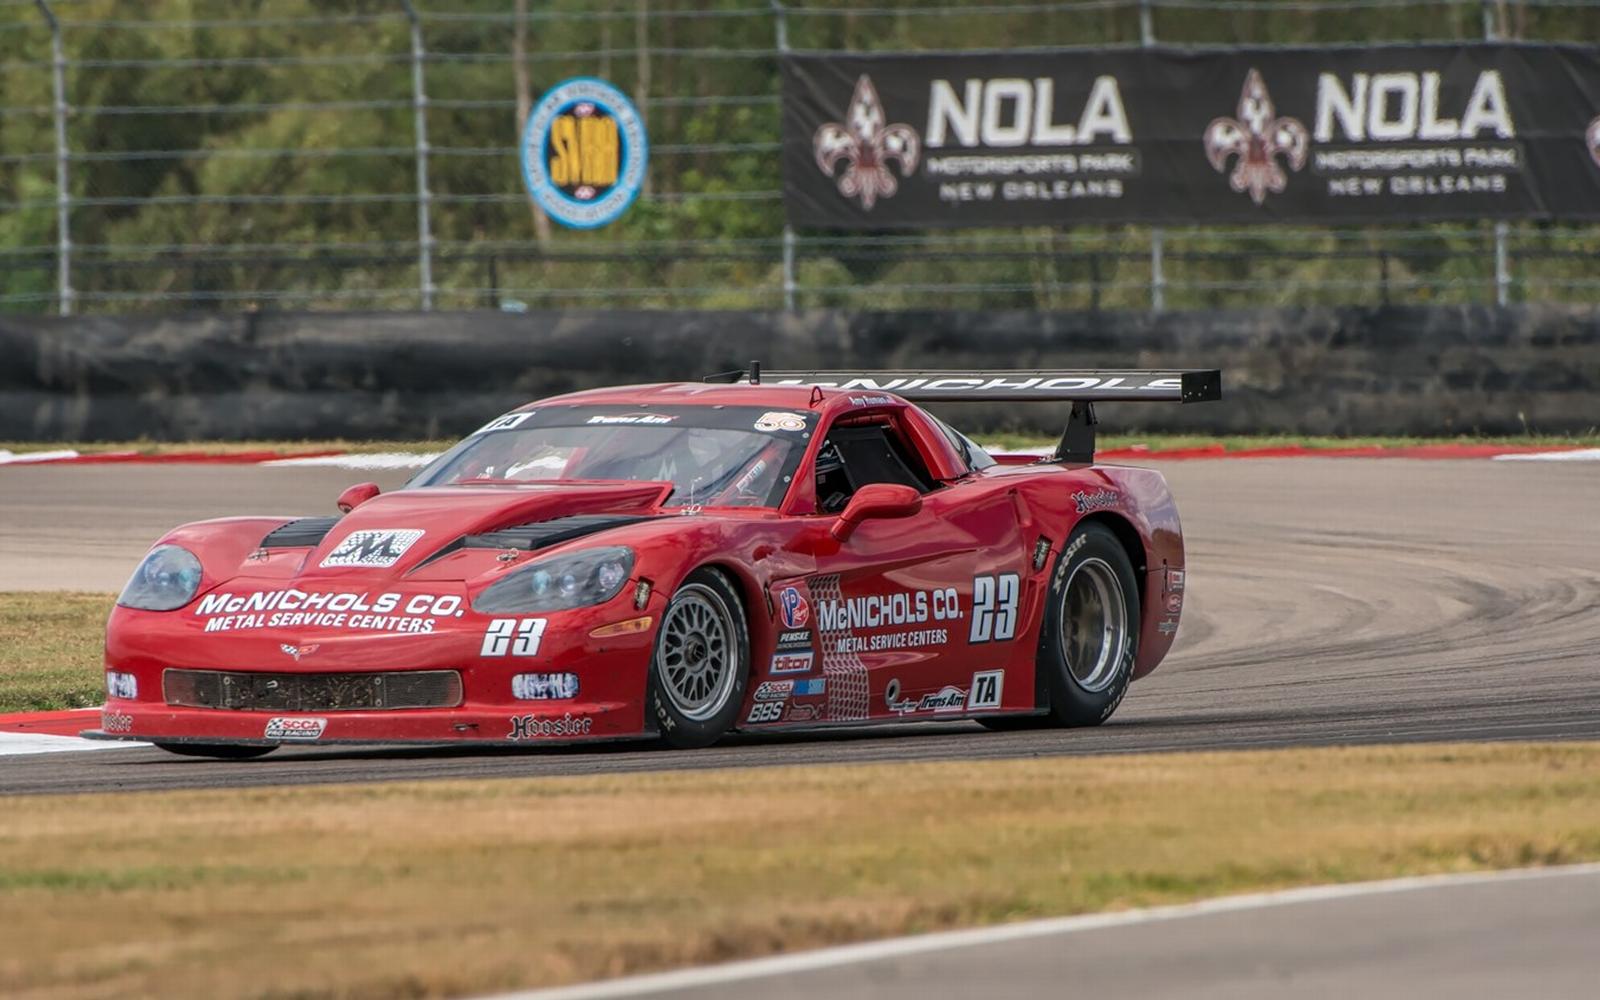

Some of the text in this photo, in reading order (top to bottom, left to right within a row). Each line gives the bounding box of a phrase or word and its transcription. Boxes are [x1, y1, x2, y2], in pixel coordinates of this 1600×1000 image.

[925, 75, 1132, 147] NOLA
[1314, 70, 1515, 142] NOLA
[926, 153, 1135, 175] MOTORSPORTS PARK
[1315, 147, 1518, 170] MOTORSPORTS PARK
[939, 179, 1124, 202] NEW ORLEANS
[1328, 175, 1507, 196] NEW ORLEANS
[194, 588, 465, 618] McNICHOLS CO.
[818, 595, 928, 632] McNICHOLS
[932, 588, 964, 620] CO.
[968, 573, 1021, 644] 23
[204, 612, 434, 634] METAL SERVICE CENTERS
[479, 617, 549, 657] 23
[837, 629, 948, 654] METAL SERVICE CENTERS
[919, 694, 946, 709] Trans
[945, 692, 965, 707] Am
[976, 675, 997, 704] TA
[747, 701, 785, 722] BBS
[266, 728, 321, 738] PRO RACING
[281, 719, 322, 730] SCCA
[507, 713, 592, 740] Hoosier
